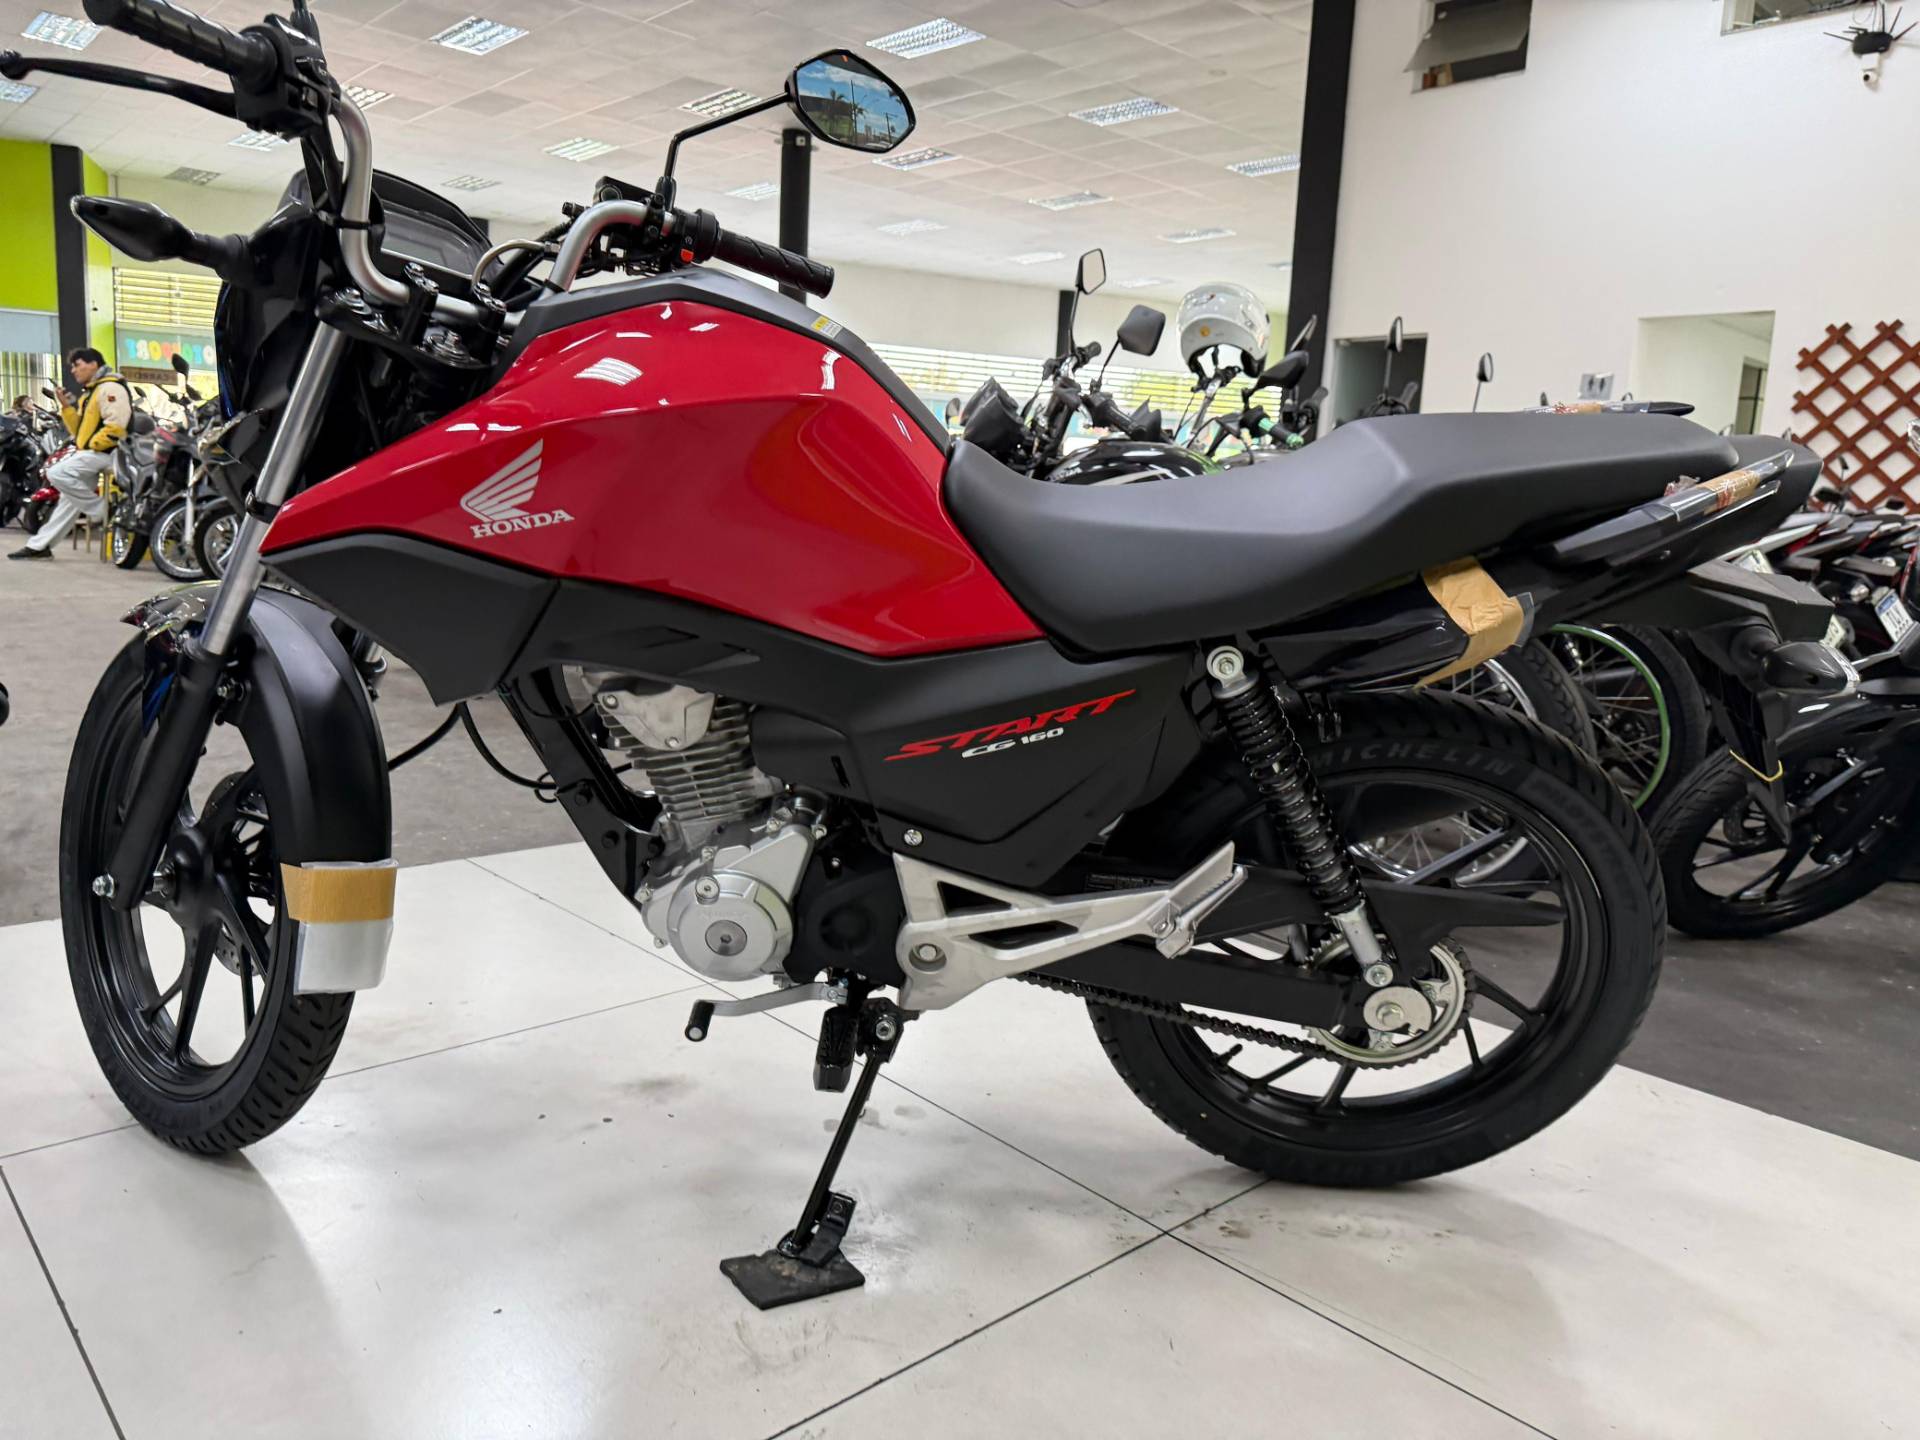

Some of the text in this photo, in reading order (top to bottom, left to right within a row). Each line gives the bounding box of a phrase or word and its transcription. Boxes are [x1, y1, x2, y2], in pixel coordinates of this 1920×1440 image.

[470, 508, 575, 539] HONDA
[883, 688, 1136, 761] START
[961, 727, 1065, 759] CG 160
[1311, 743, 1514, 776] MICHELIN
